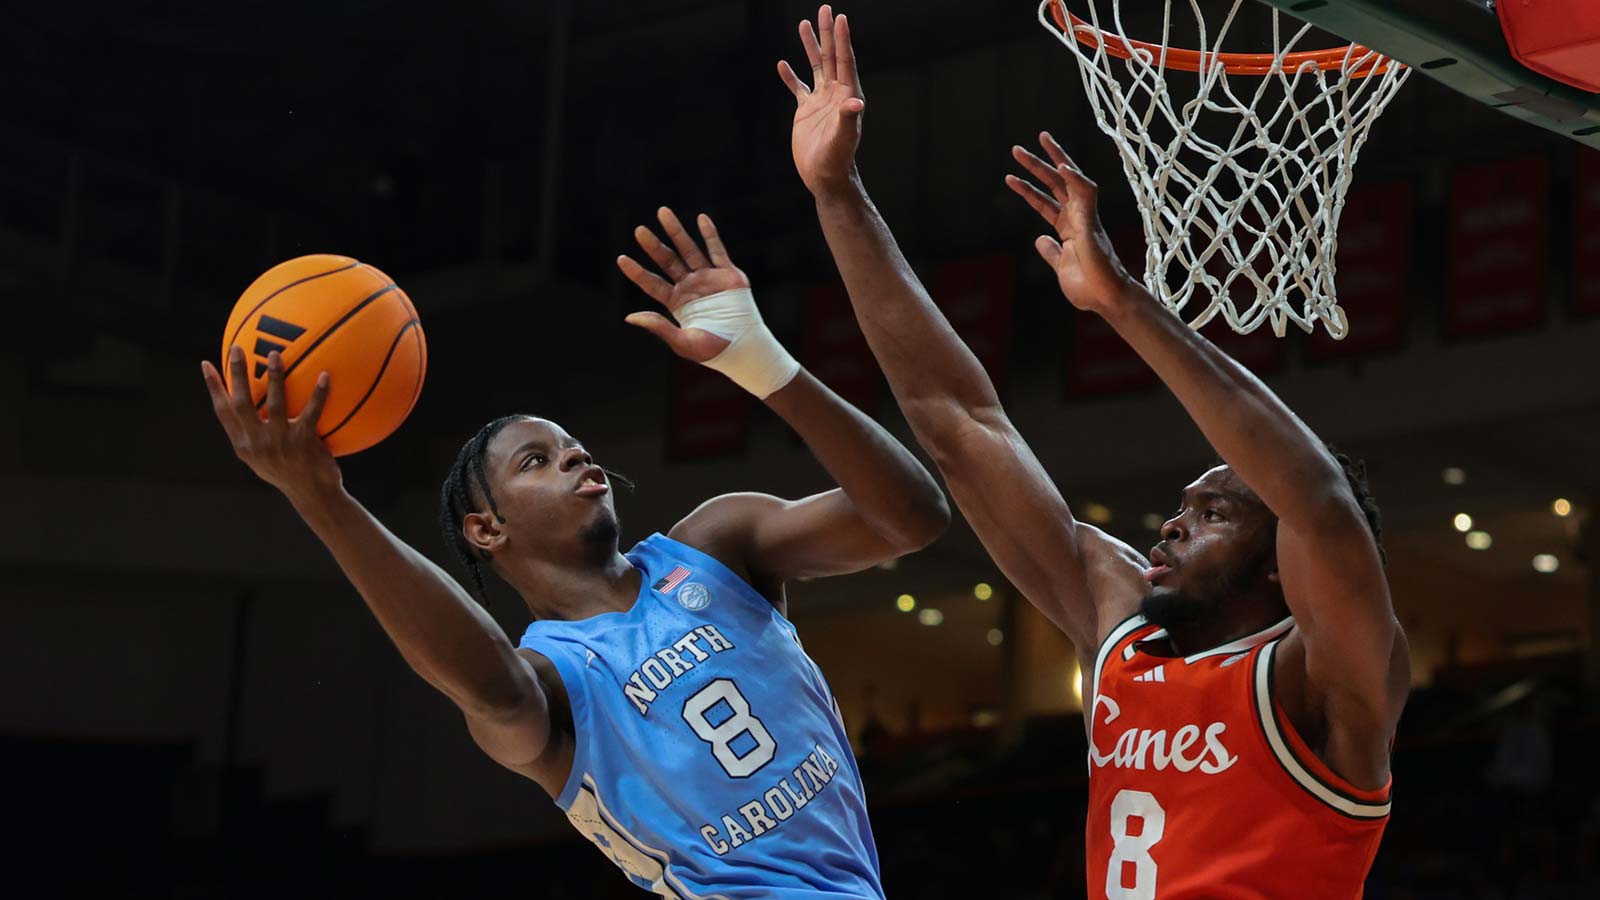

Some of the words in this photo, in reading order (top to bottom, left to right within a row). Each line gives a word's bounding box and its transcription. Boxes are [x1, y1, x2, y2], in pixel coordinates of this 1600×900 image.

[624, 624, 735, 715] NORTH
[682, 678, 778, 778] 8
[1090, 694, 1238, 774] Canes
[700, 744, 839, 856] CAROLINA
[1105, 789, 1166, 900] 8
